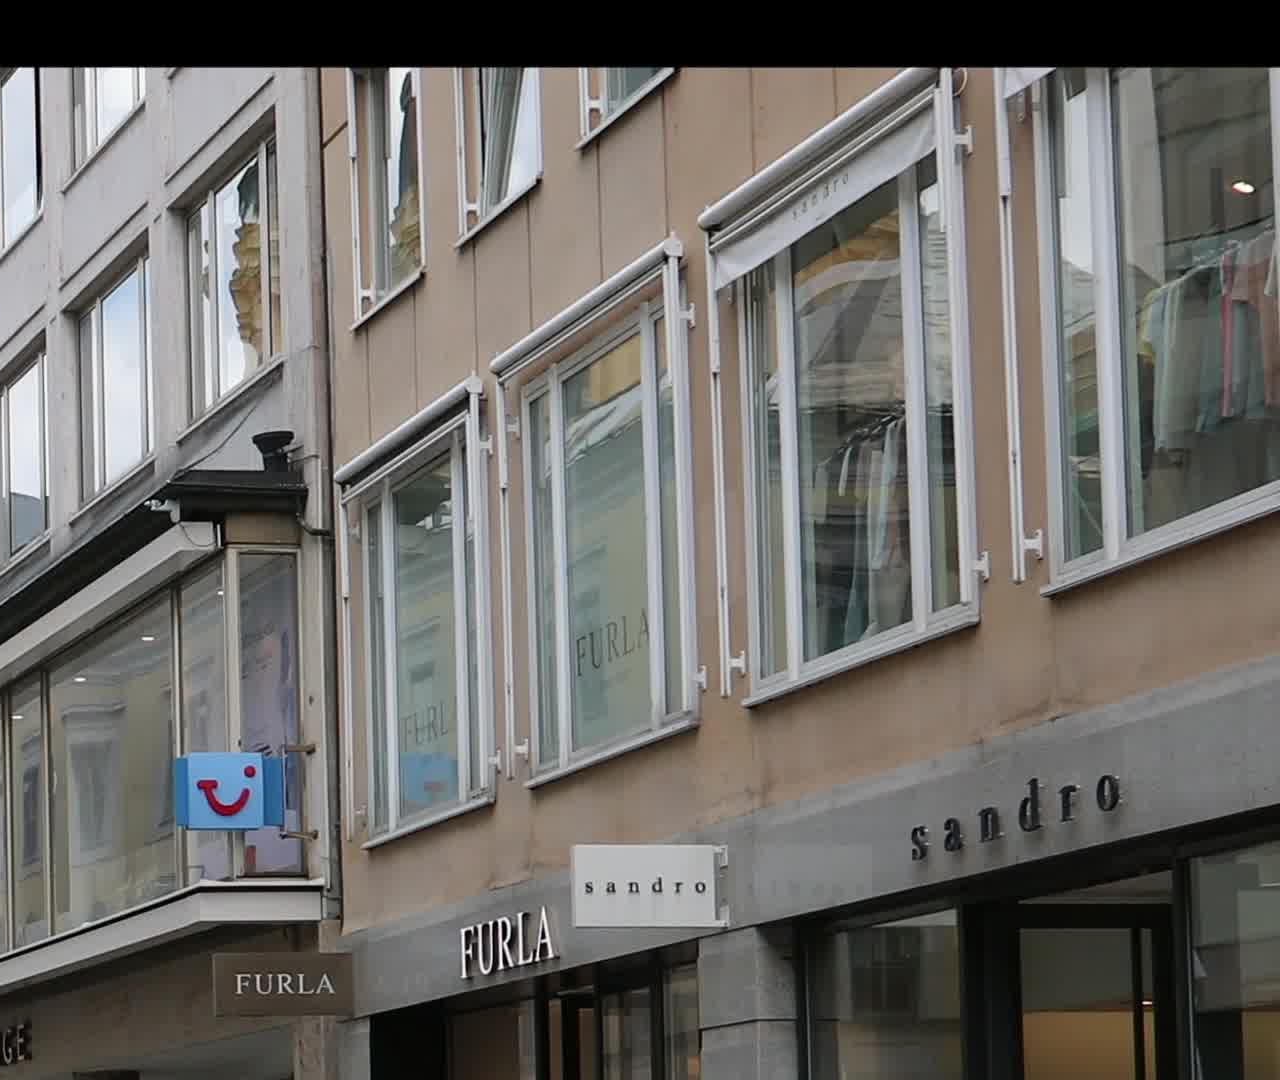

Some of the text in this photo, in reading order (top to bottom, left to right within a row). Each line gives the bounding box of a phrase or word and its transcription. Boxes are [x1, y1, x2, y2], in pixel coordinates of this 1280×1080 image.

[575, 606, 651, 678] FURLA
[911, 773, 1123, 862] sandro
[584, 875, 708, 896] sandro
[459, 904, 556, 979] FURLA
[234, 973, 336, 995] FURLA
